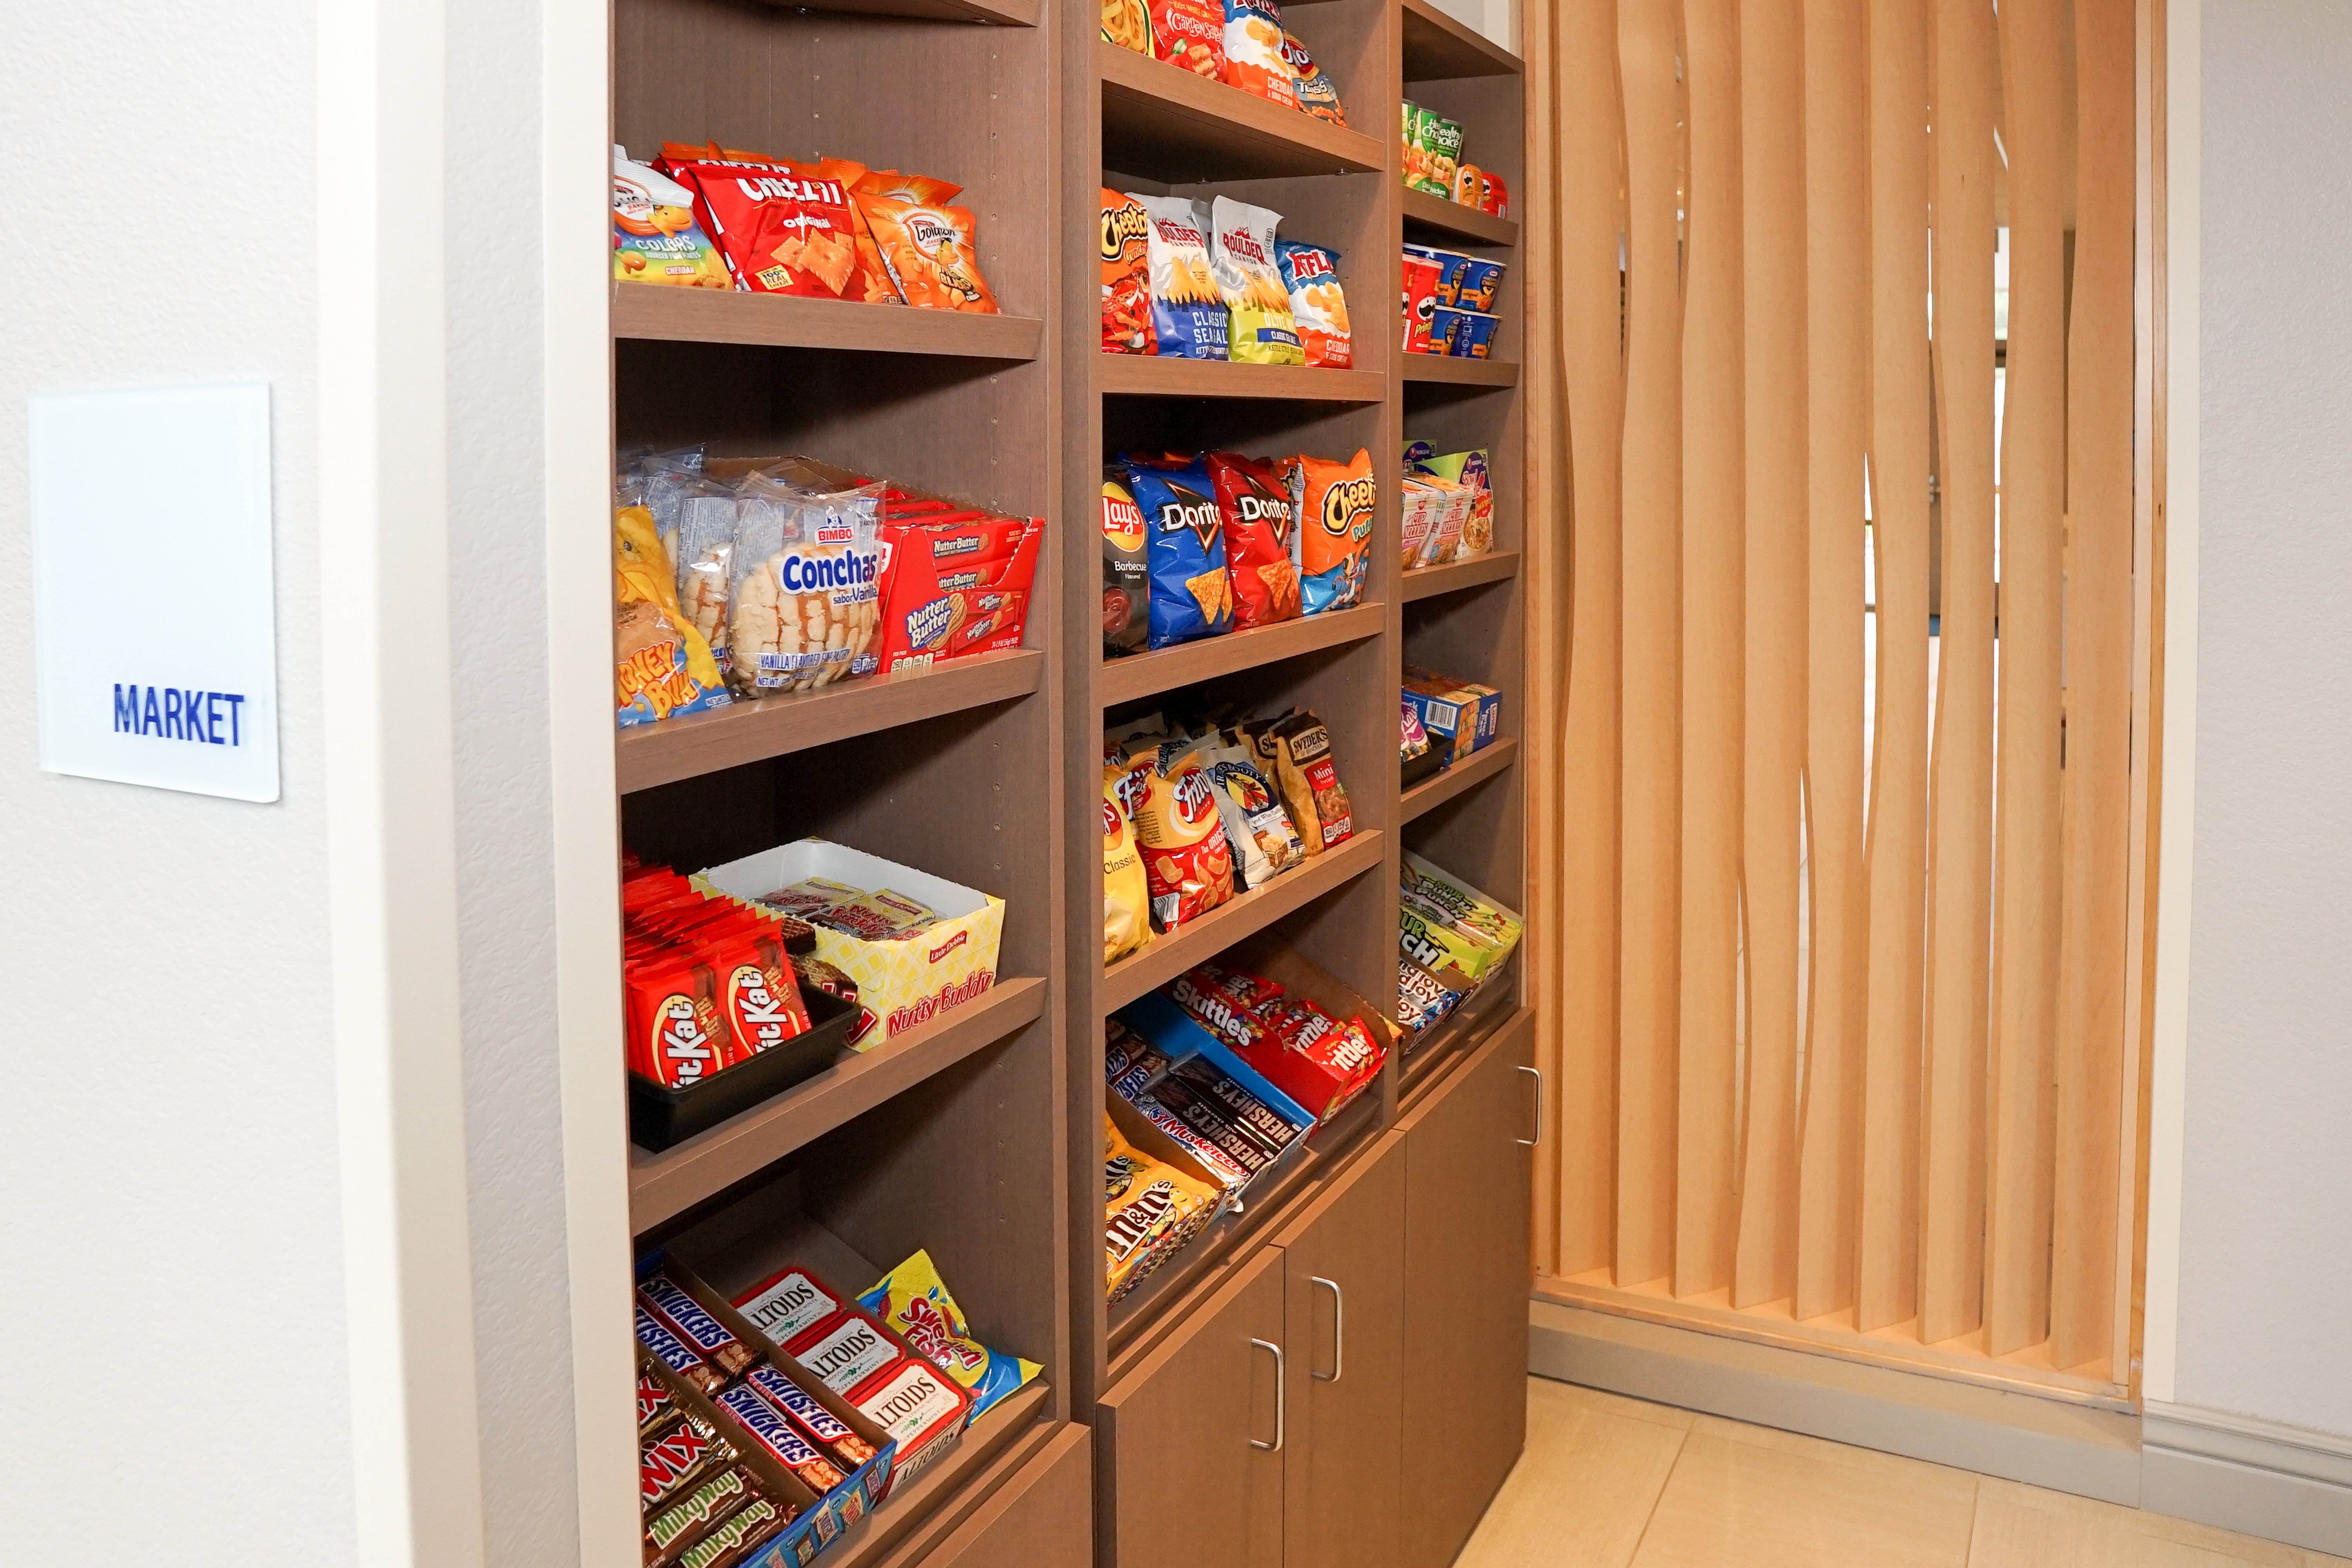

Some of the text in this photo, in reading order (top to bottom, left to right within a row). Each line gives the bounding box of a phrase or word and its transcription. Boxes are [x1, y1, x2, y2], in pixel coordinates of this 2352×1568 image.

[1422, 125, 1439, 139] Cho
[1438, 137, 1459, 149] oice
[1440, 126, 1462, 140] ealthy
[1430, 186, 1446, 196] hicken
[1101, 205, 1147, 256] Cheeto
[1222, 232, 1271, 266] BOULDER
[1414, 320, 1433, 338] Pring
[1102, 497, 1140, 536] Lay's
[1163, 501, 1223, 531] Dorito
[1240, 495, 1291, 521] Dorito
[1326, 480, 1375, 530] Cheet
[818, 528, 852, 541] BIMBO
[934, 537, 979, 553] Nutter Butter
[782, 550, 877, 591] Conchas
[938, 572, 977, 588] utter Butter
[1114, 560, 1147, 572] Barbecue
[833, 593, 853, 604] sabor
[907, 597, 948, 634] Nutter
[911, 609, 951, 648] Butter
[761, 654, 789, 670] VANILLA
[643, 670, 699, 720] BUN
[757, 677, 769, 686] NET
[114, 683, 245, 746] MARKET
[1293, 728, 1328, 754] SNYDER'S
[1314, 763, 1334, 780] Mini
[1103, 852, 1136, 875] Classic
[1401, 911, 1426, 938] UR
[930, 934, 965, 961] Little Debbie
[887, 968, 994, 1039] Nutty Buddy
[1172, 980, 1252, 1046] Skittles
[1399, 1002, 1421, 1021] oy
[1294, 1013, 1334, 1051] kittles
[1330, 1034, 1373, 1071] ittles
[1149, 1107, 1170, 1124] 3
[1212, 1080, 1294, 1143] HERSHEY'S
[1182, 1105, 1265, 1171] HERSHEY'S
[647, 1278, 733, 1348] SNICKERS
[750, 1283, 815, 1330] LTOIDS
[753, 1369, 848, 1438] SATISFIES
[722, 1390, 817, 1462] SNICKERS
[906, 1410, 941, 1439] PEPPERMINT
[649, 1470, 743, 1549] Milky Way
[731, 1500, 775, 1536] Way
